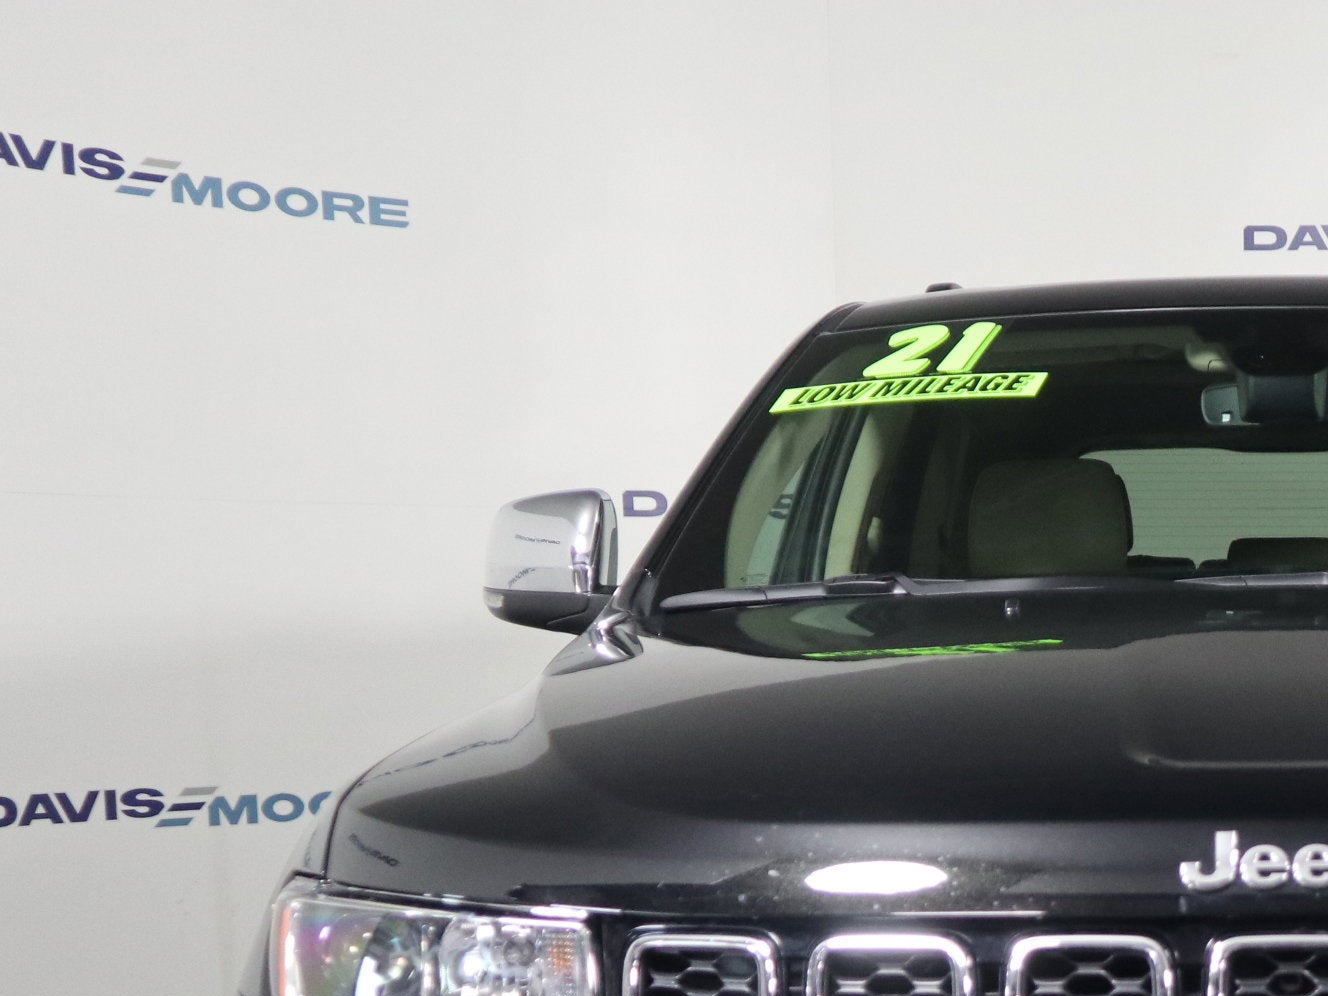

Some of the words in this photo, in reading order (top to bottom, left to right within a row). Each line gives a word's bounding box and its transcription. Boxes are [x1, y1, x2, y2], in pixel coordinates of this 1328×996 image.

[171, 172, 410, 228] MOORE
[863, 321, 1002, 377] 21
[790, 383, 867, 405] LOW
[870, 374, 1030, 398] MILEAGE
